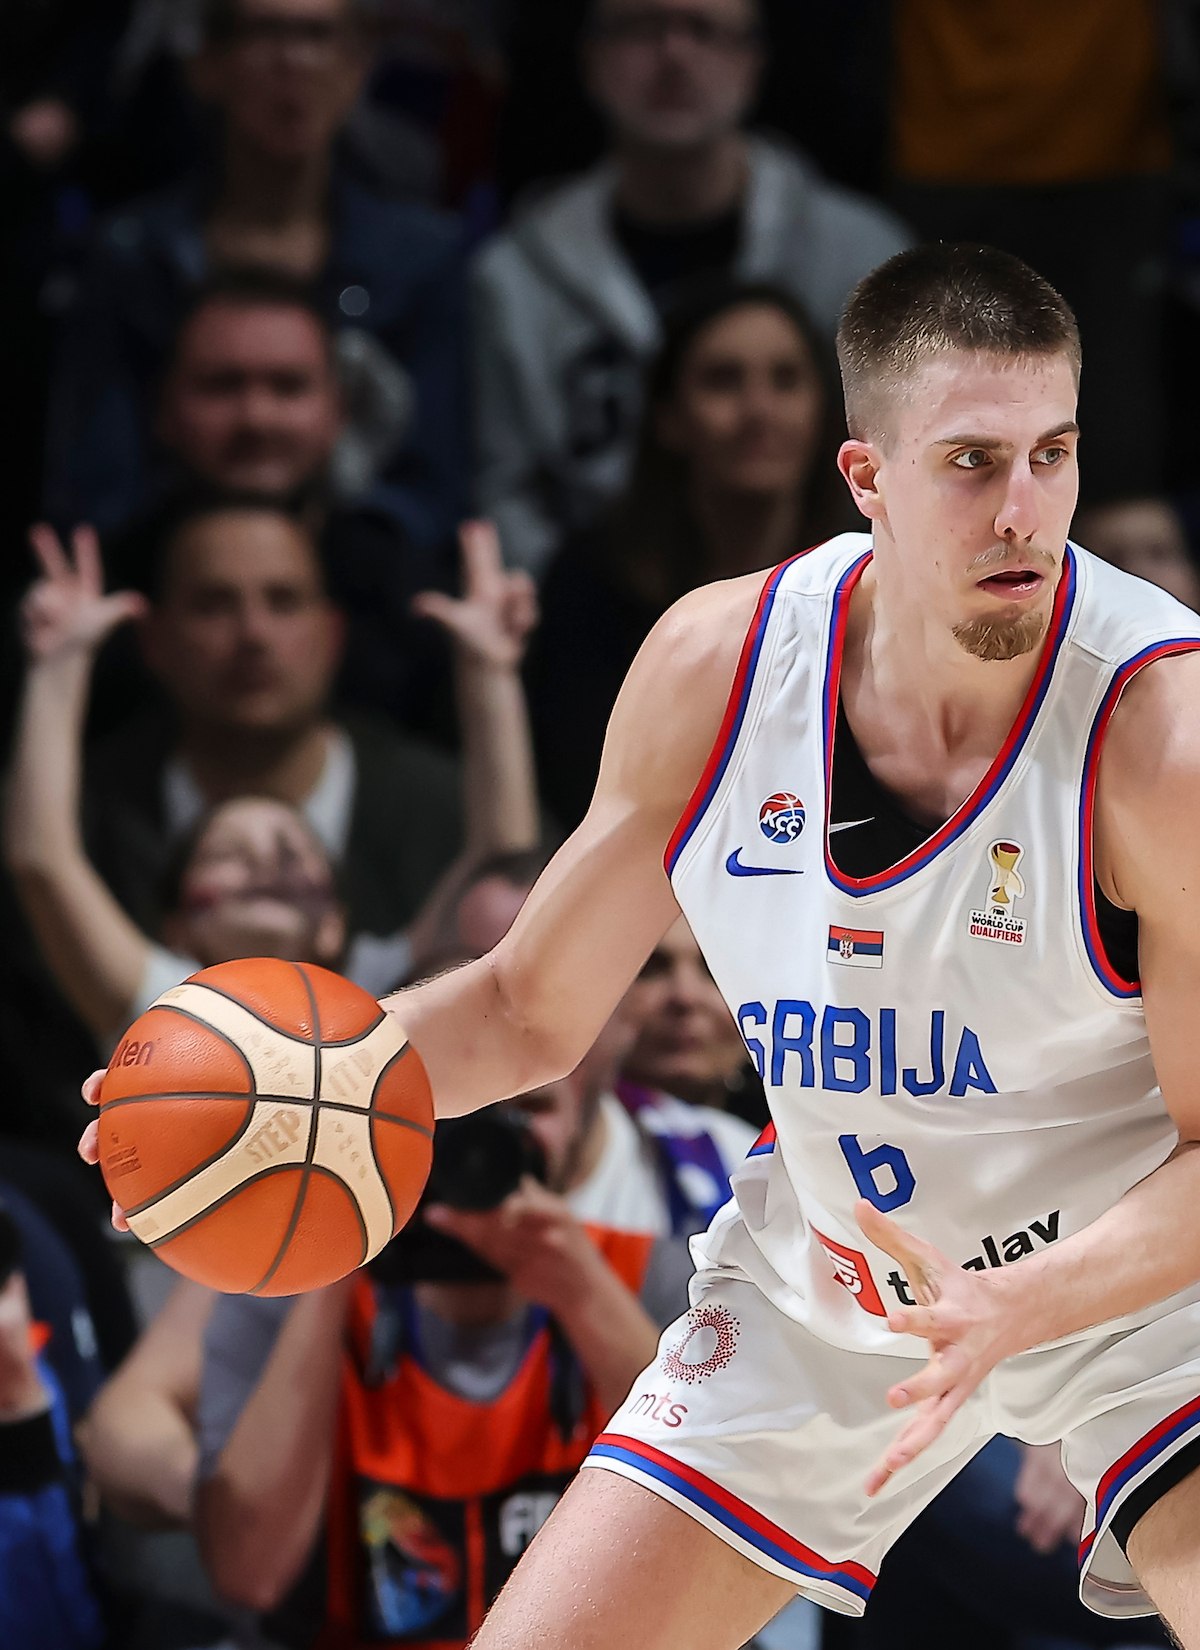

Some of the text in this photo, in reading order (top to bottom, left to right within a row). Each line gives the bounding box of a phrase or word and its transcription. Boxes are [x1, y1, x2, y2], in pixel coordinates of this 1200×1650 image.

[970, 924, 1023, 943] QUALIFIERS
[971, 915, 1004, 929] WORLD
[1005, 923, 1024, 933] CUP
[737, 999, 1000, 1098] SRBIJA
[838, 1133, 917, 1214] 6
[627, 1391, 689, 1428] mts
